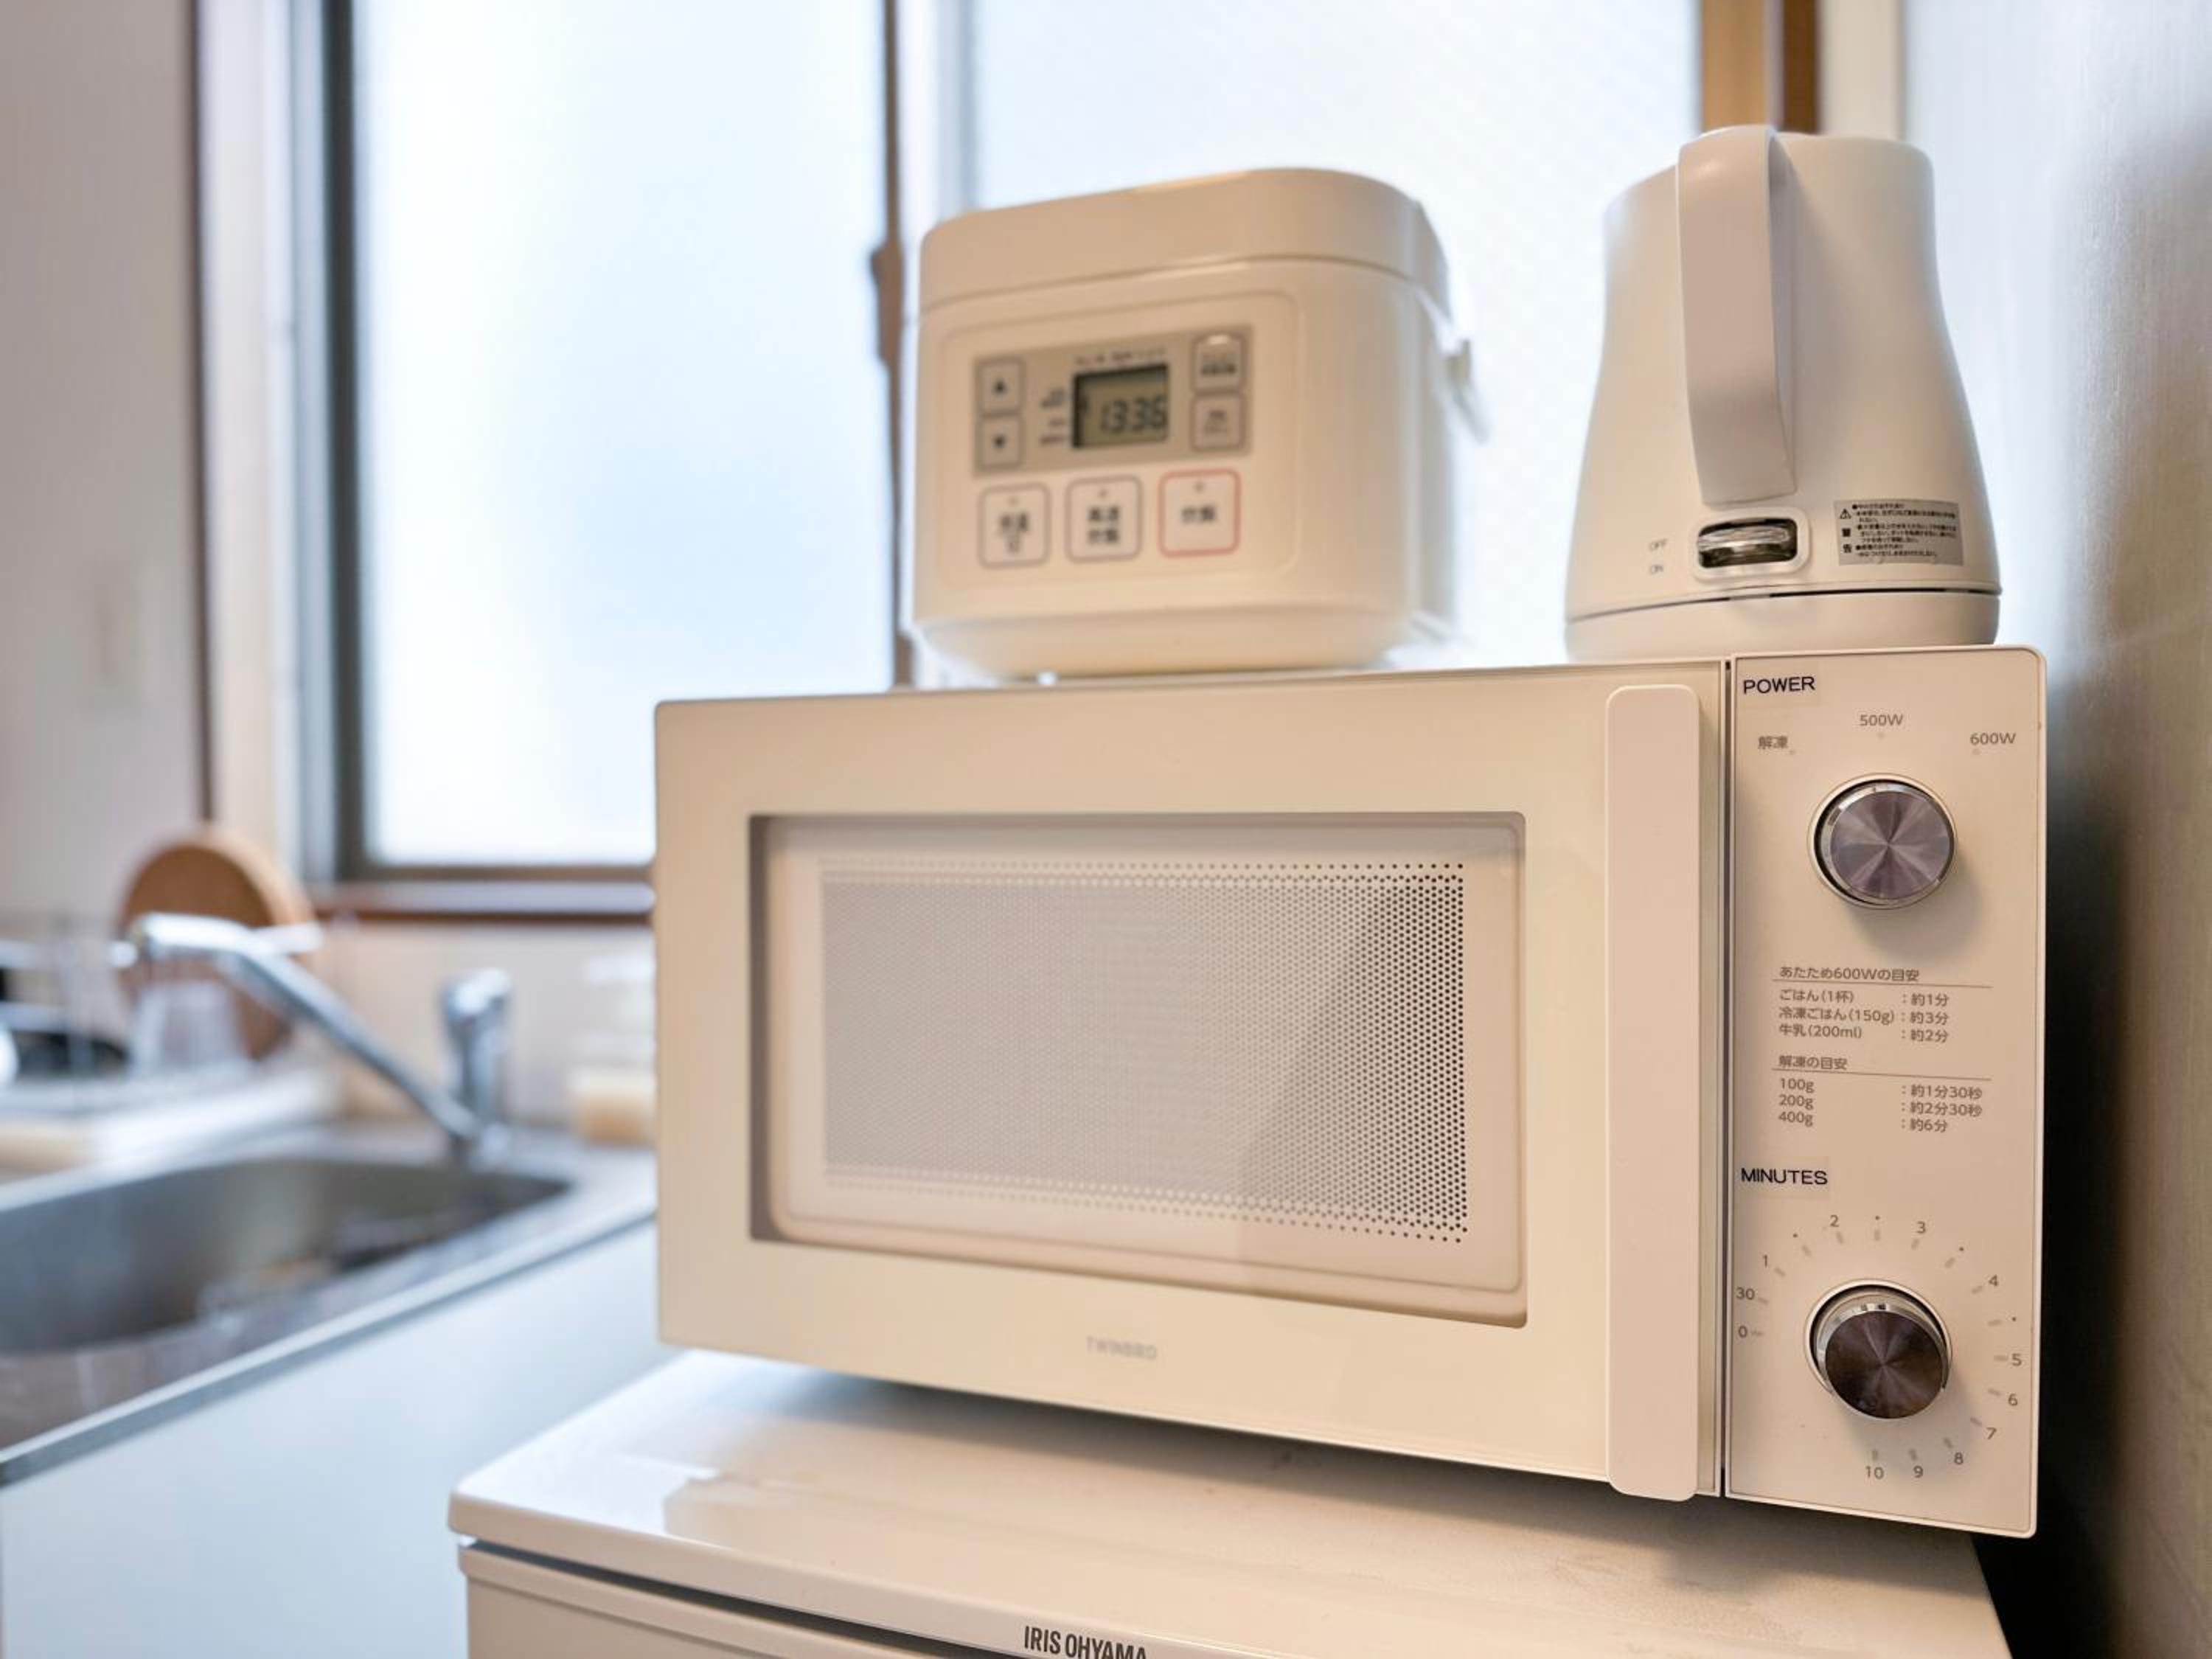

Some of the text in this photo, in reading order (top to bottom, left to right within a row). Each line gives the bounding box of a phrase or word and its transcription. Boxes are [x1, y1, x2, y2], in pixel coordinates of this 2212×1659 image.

[1648, 538, 1669, 552] OFF
[1743, 676, 1815, 694] POWER
[1860, 714, 1904, 726] 500W
[1757, 735, 1788, 749] 解凍
[1970, 732, 2016, 745] 600W
[1778, 967, 1919, 982] あたため600Wの目安
[1778, 1055, 1848, 1071] 解凍の目安
[1781, 1078, 1815, 1093] 100g
[1779, 1095, 1814, 1110] 200g
[1778, 1111, 1813, 1127] 400g
[1742, 1168, 1828, 1185] MINUTES
[1830, 1214, 1839, 1227] 2
[1916, 1221, 1926, 1234] 3
[1763, 1255, 1767, 1267] 1
[1988, 1275, 1998, 1287] 4
[1736, 1287, 1756, 1300] 30
[1739, 1326, 1748, 1338] 0
[2012, 1353, 2022, 1366] 5
[2008, 1394, 2018, 1406] 6
[1986, 1427, 1997, 1439] 7
[1954, 1452, 1964, 1465] 8
[1865, 1465, 1885, 1480] 10
[1913, 1465, 1923, 1478] 9
[1024, 1626, 1061, 1655] IRIS
